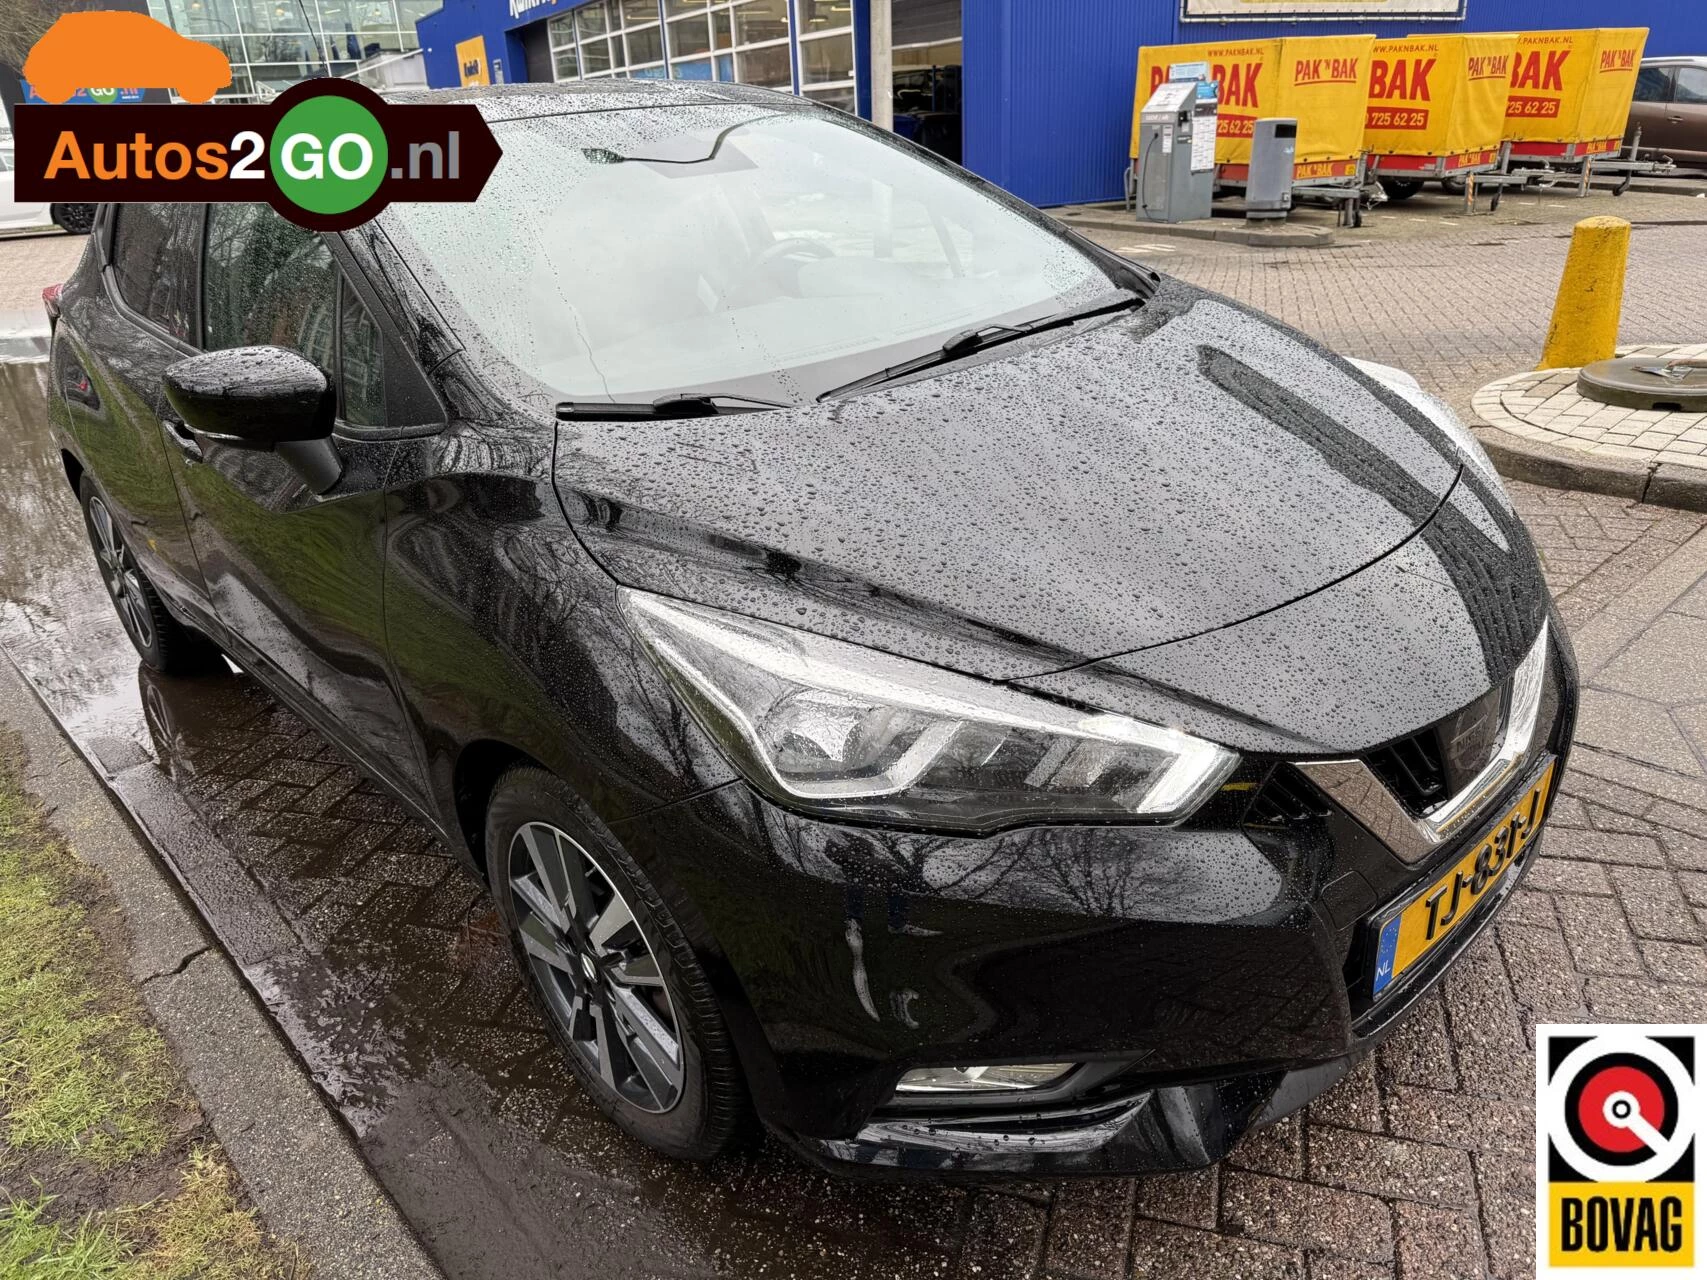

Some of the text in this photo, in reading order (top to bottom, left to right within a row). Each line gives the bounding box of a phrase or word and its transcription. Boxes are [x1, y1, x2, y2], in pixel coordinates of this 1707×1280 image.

[1295, 59, 1322, 81] PAK
[1331, 57, 1358, 79] BAK
[1468, 56, 1486, 76] PAK
[1491, 54, 1509, 74] BAK
[1368, 58, 1437, 101] BAK
[1524, 101, 1539, 114] 62
[1540, 101, 1557, 114] 25
[1229, 119, 1241, 134] 62
[1241, 119, 1254, 134] 25
[1371, 112, 1391, 126] 725
[1393, 112, 1408, 126] 62
[1409, 112, 1425, 126] 25
[1375, 961, 1391, 981] NL
